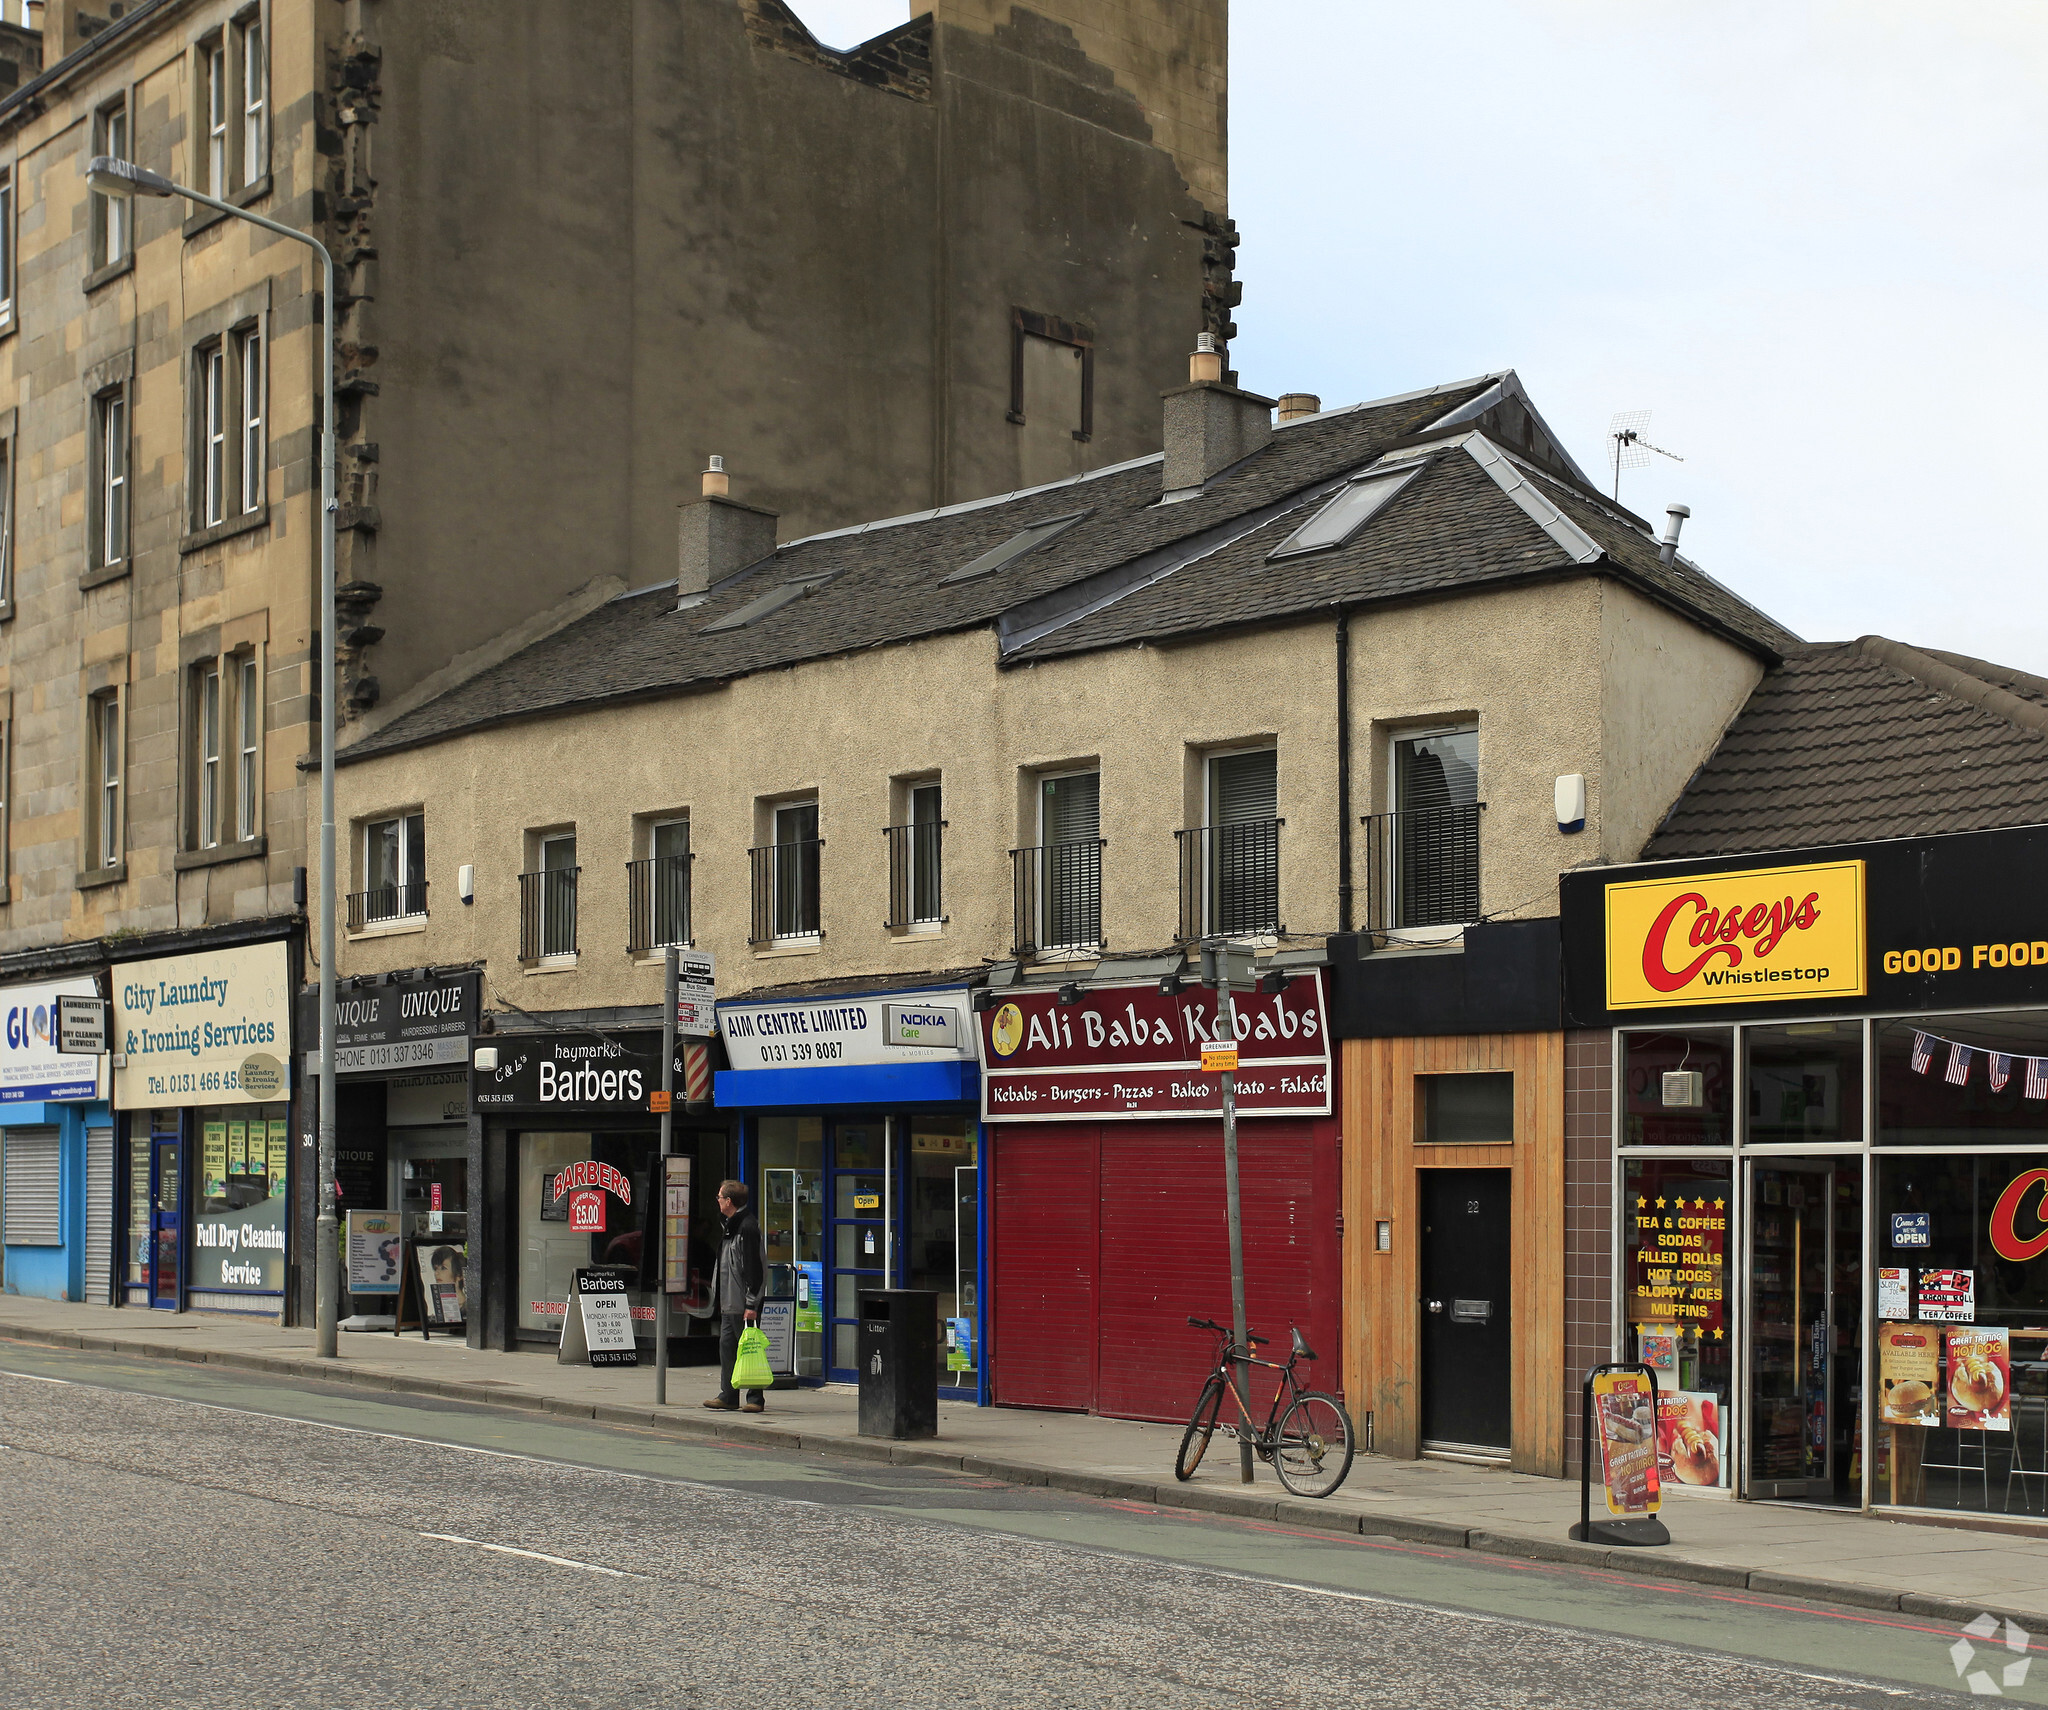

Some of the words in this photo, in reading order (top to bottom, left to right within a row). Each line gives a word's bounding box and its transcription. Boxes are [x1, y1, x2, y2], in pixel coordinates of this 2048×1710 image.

[1641, 891, 1822, 993] Caseys
[1883, 946, 1961, 975] GOOD
[1972, 941, 2048, 970] FOOD
[1702, 966, 1830, 987] Whistlestop
[124, 983, 155, 1015] City
[160, 976, 228, 1007] Laundry
[63, 1001, 101, 1009] LAUNDERETTE
[401, 986, 462, 1019] UNIQUE
[335, 999, 380, 1027] NIQUE
[70, 1016, 94, 1024] IRONING
[727, 1015, 755, 1038] AIM
[757, 1012, 808, 1035] CENTRE
[810, 1008, 867, 1032] LIMITED
[901, 1014, 947, 1026] NOKIA
[401, 1025, 438, 1038] HAIRDRESSING
[441, 1022, 466, 1034] BARBERS
[901, 1027, 920, 1039] Care
[1026, 1007, 1073, 1051] Ali
[1080, 1003, 1174, 1048] Baba
[75, 1031, 103, 1039] CLEANING
[126, 1030, 138, 1055] &
[142, 1024, 200, 1056] Ironing
[203, 1017, 274, 1048] Services
[69, 1039, 96, 1047] SERVICES
[370, 1048, 390, 1065] 0131
[394, 1046, 409, 1062] 337
[412, 1043, 434, 1060] 3346
[555, 1042, 622, 1063] haymarket
[761, 1045, 788, 1062] 0131
[792, 1044, 812, 1061] 539
[815, 1042, 843, 1060] 8087
[244, 1063, 259, 1071] City
[253, 1077, 279, 1085] Ironing
[495, 1069, 504, 1083] C
[505, 1066, 514, 1078] &
[149, 1076, 167, 1094] Tel.
[170, 1074, 196, 1092] 0131
[200, 1072, 220, 1091] 466
[223, 1071, 243, 1090] 45
[540, 1061, 643, 1102] Barbers
[994, 1086, 1038, 1103] Kebabs
[1051, 1086, 1101, 1104] Burgers
[1113, 1084, 1154, 1099] Pizzas
[1171, 1081, 1209, 1099] Baked
[1280, 1074, 1326, 1095] Falafel
[477, 1095, 490, 1103] 0131
[491, 1094, 500, 1102] 313
[502, 1094, 514, 1102] 1158
[303, 1134, 313, 1147] 30
[335, 1150, 374, 1161] NIQUE
[554, 1161, 631, 1206] BARBERS
[571, 1192, 589, 1210] CLIPPER
[589, 1193, 601, 1206] CUTS
[858, 1197, 875, 1206] Open
[1467, 1201, 1480, 1213] 22
[576, 1205, 599, 1224] £5.00
[1636, 1217, 1660, 1229] TEA
[1664, 1217, 1673, 1229] &
[1678, 1217, 1726, 1230] COFFEE
[1895, 1216, 1914, 1228] Come
[1915, 1216, 1926, 1227] In
[196, 1223, 217, 1247] Full
[219, 1224, 238, 1252] Dry
[1658, 1235, 1702, 1247] SODAS
[1895, 1233, 1927, 1244] OPEN
[1637, 1252, 1678, 1264] FILLED
[1682, 1253, 1723, 1265] ROLLS
[221, 1260, 261, 1285] Service
[1647, 1269, 1673, 1281] HOT
[1677, 1270, 1712, 1282] DOGS
[580, 1278, 624, 1290] Barbers
[1880, 1281, 1900, 1289] SLOPPY
[1953, 1274, 1971, 1292] £2
[1637, 1286, 1686, 1299] SLOPPY
[1690, 1288, 1723, 1300] JOES
[1923, 1294, 1947, 1302] BACON
[1953, 1294, 1974, 1303] ROLL
[531, 1301, 544, 1314] THE
[595, 1300, 617, 1309] OPEN
[761, 1306, 788, 1314] OKIA
[1651, 1303, 1709, 1318] MUFFINS
[868, 1323, 886, 1333] Litter
[1950, 1336, 1972, 1346] GREAT
[1974, 1332, 2002, 1343] TASTING
[1953, 1345, 1975, 1357] HOT
[1977, 1342, 2002, 1354] DOG
[593, 1354, 608, 1362] 0131
[609, 1353, 621, 1362] 313
[623, 1353, 637, 1361] 1158
[1664, 1397, 1688, 1405] TASTING
[1666, 1405, 1688, 1416] DOG
